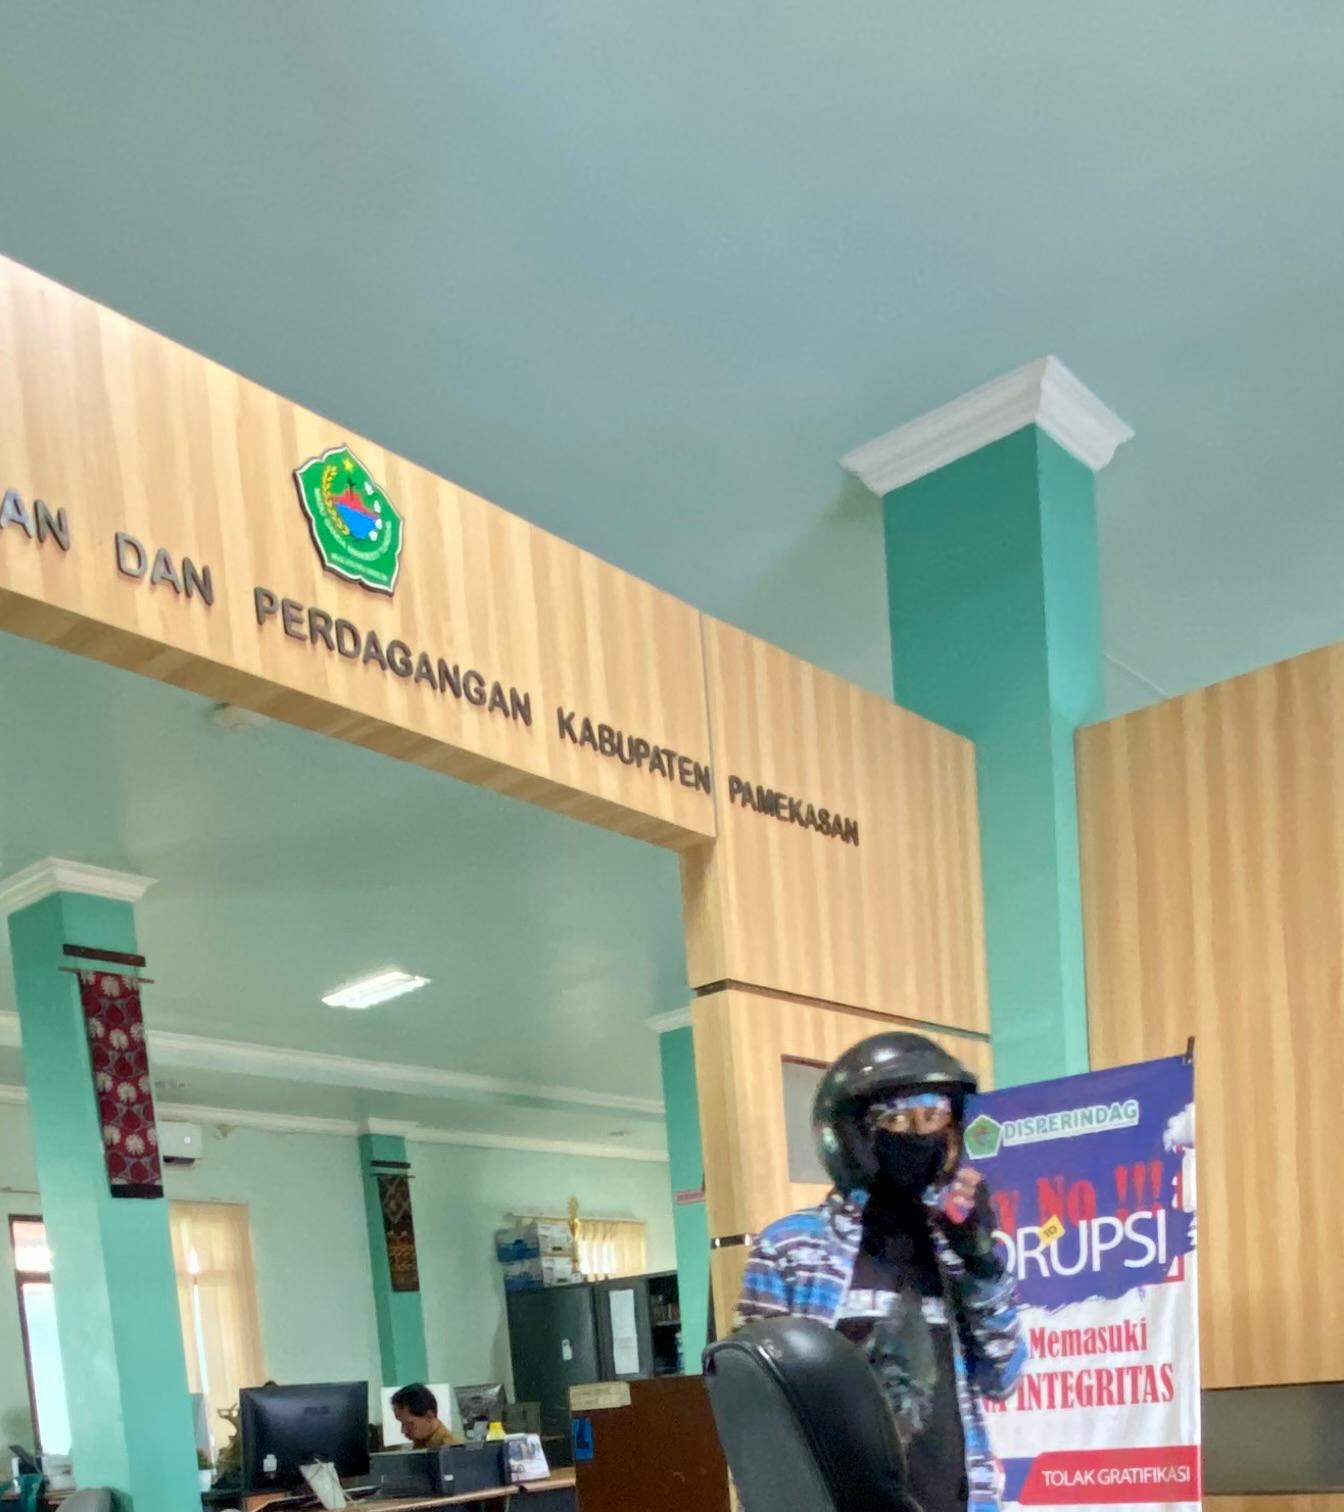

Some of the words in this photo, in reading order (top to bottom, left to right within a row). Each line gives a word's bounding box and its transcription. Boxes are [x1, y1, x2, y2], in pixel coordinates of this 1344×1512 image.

[114, 531, 214, 605] DAN
[254, 586, 532, 726] PERDAGANGAN
[557, 707, 711, 794] KABUPATEN
[728, 774, 860, 846] PAMEKASAN
[1006, 1101, 1138, 1140] DISPERINDAG
[990, 1208, 1167, 1281] ORUPSI
[1028, 1316, 1148, 1360] Memasuki
[1015, 1363, 1175, 1411] INTEGRITAS
[1041, 1469, 1095, 1488] TOLAK
[1097, 1465, 1191, 1485] GRATIFIKASI
